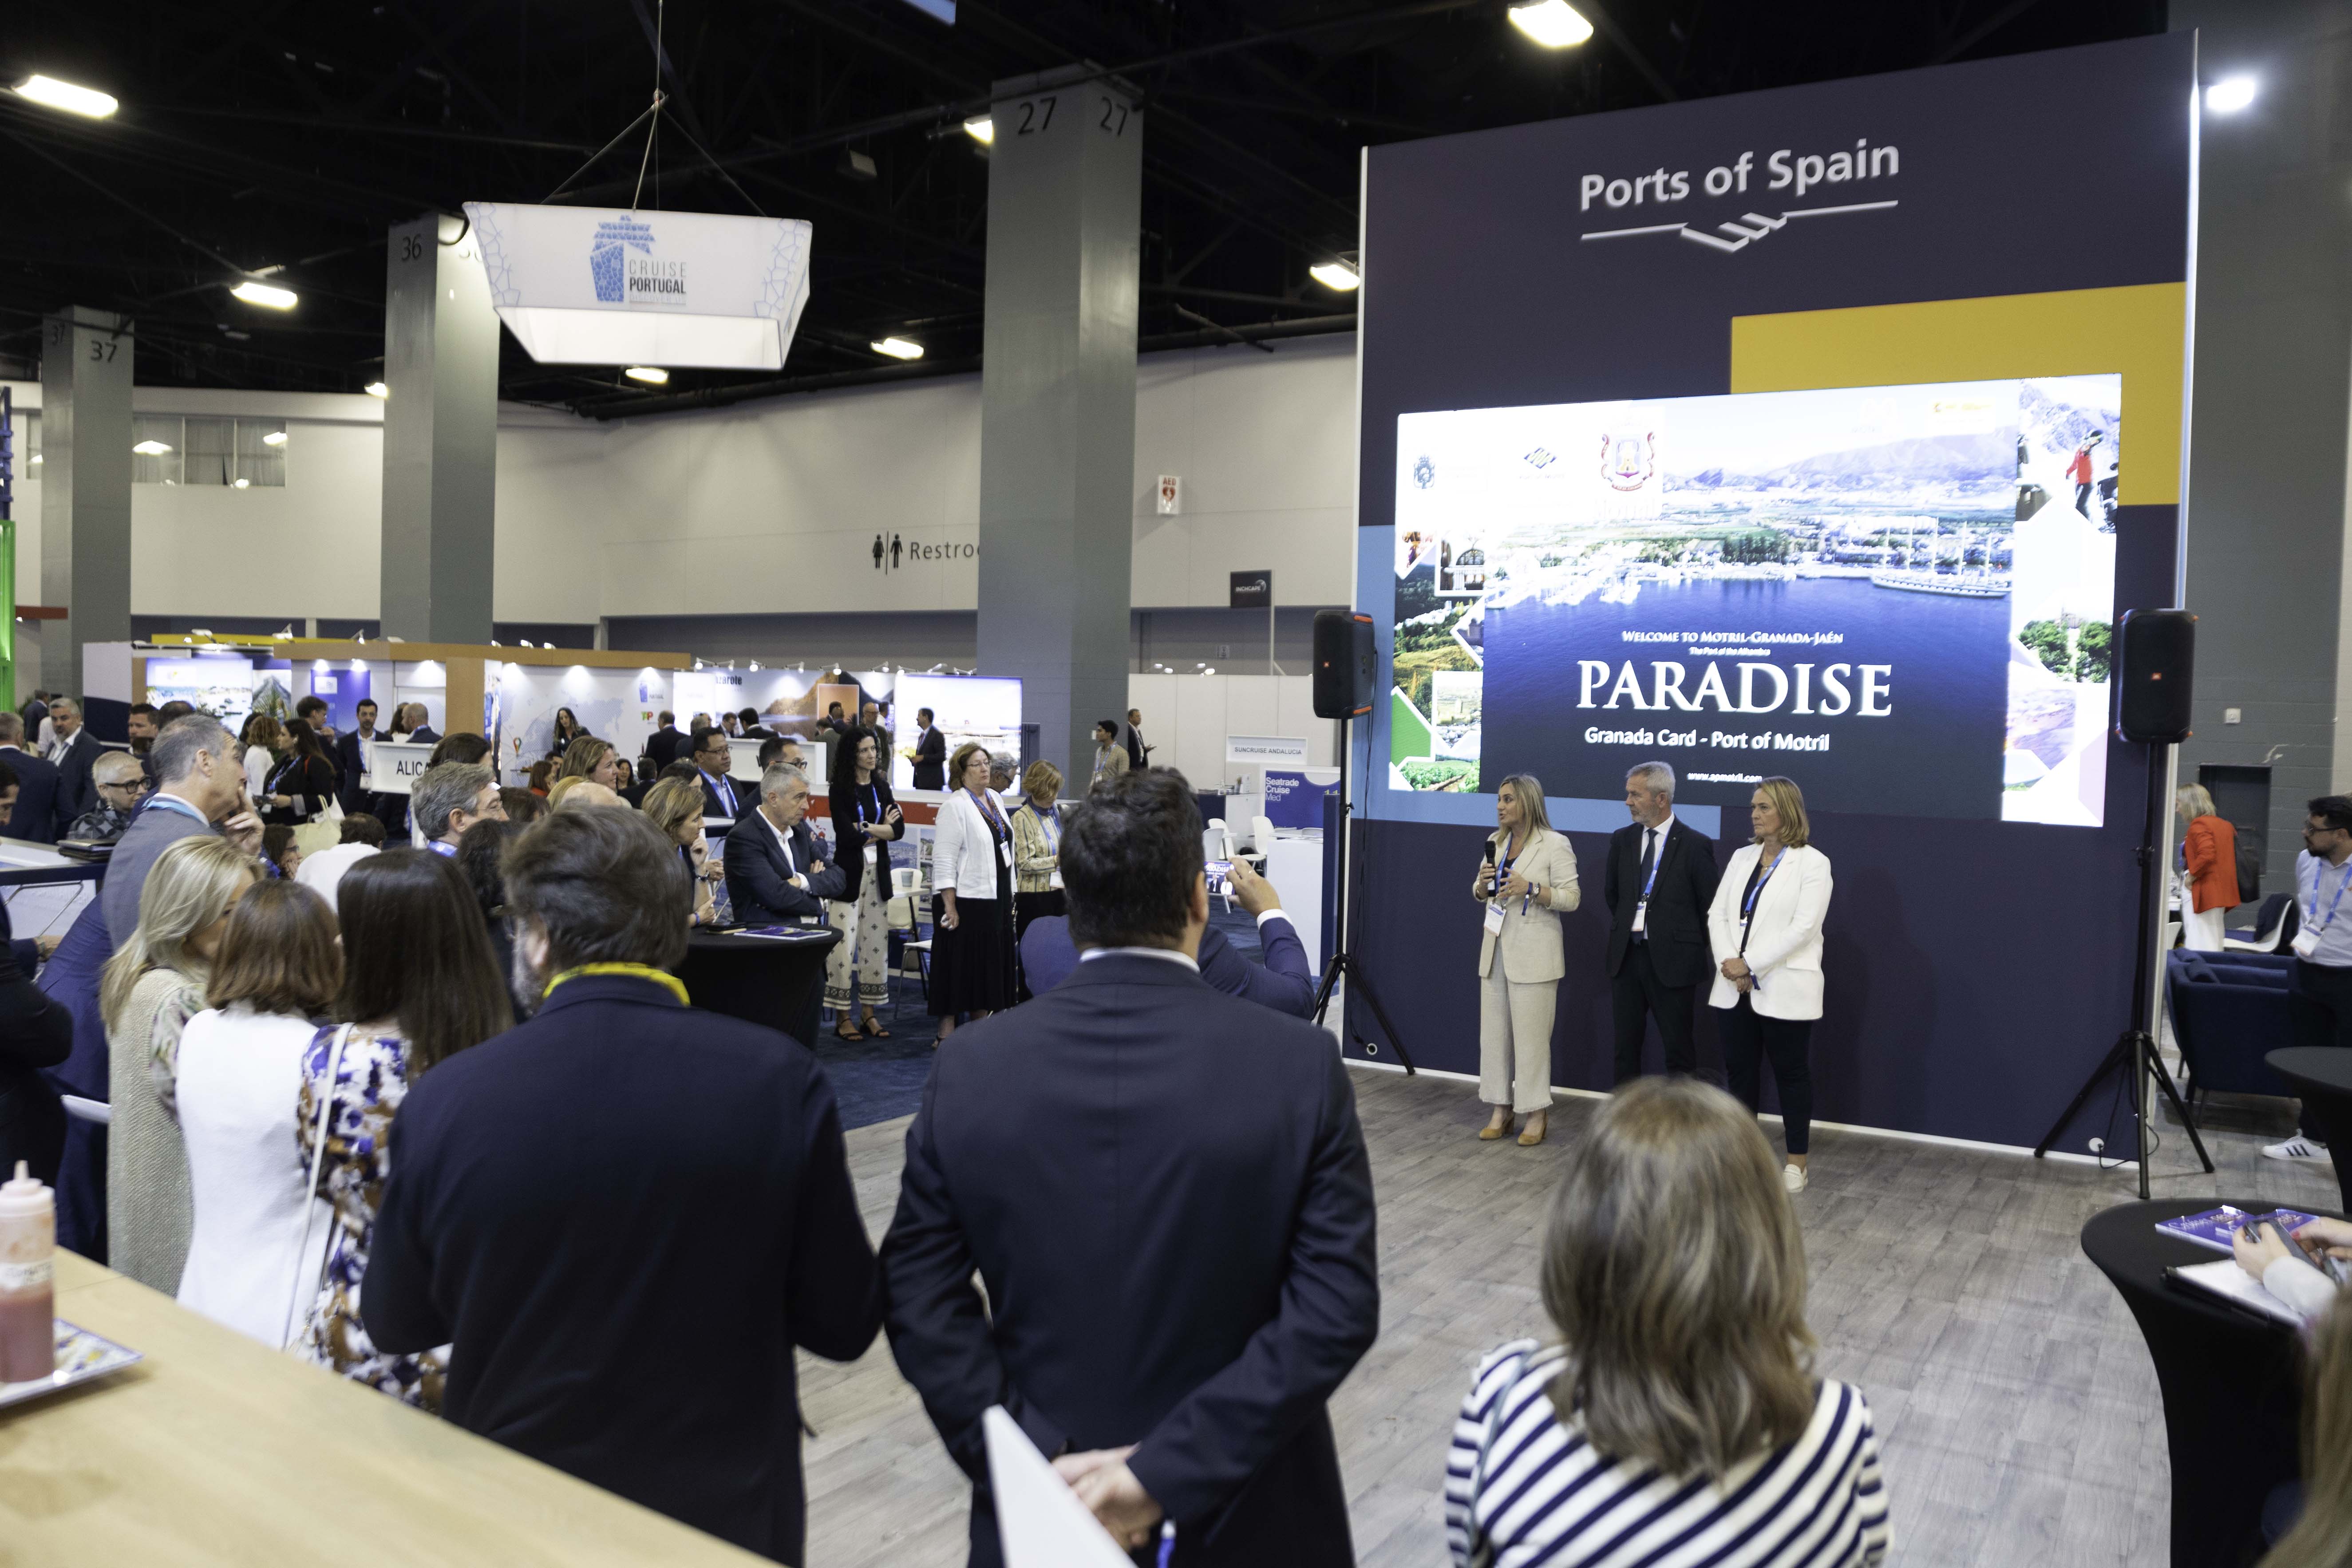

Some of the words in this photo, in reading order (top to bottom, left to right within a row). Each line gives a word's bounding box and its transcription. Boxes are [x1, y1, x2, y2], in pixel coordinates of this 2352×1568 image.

[1018, 95, 1056, 135] 27
[1100, 95, 1127, 136] 27
[1581, 167, 1689, 212] Ports
[1705, 151, 1754, 196] of
[1768, 138, 1899, 197] Spain
[402, 233, 421, 261] 36
[629, 259, 686, 277] CRUISE
[629, 276, 686, 293] PORTUGAL
[90, 340, 118, 363] 37
[1163, 477, 1176, 486] AED
[910, 541, 980, 560] Restro
[1577, 660, 1892, 716] PARADISE
[1585, 727, 1654, 745] Granada
[1657, 729, 1697, 747] Card
[1711, 731, 1749, 749] Port
[1751, 731, 1772, 750] of
[1774, 733, 1830, 751] Motril
[1266, 777, 1299, 786] Seatrade
[1687, 773, 1763, 783] www.apmotril.com
[1266, 785, 1290, 794] Cruise
